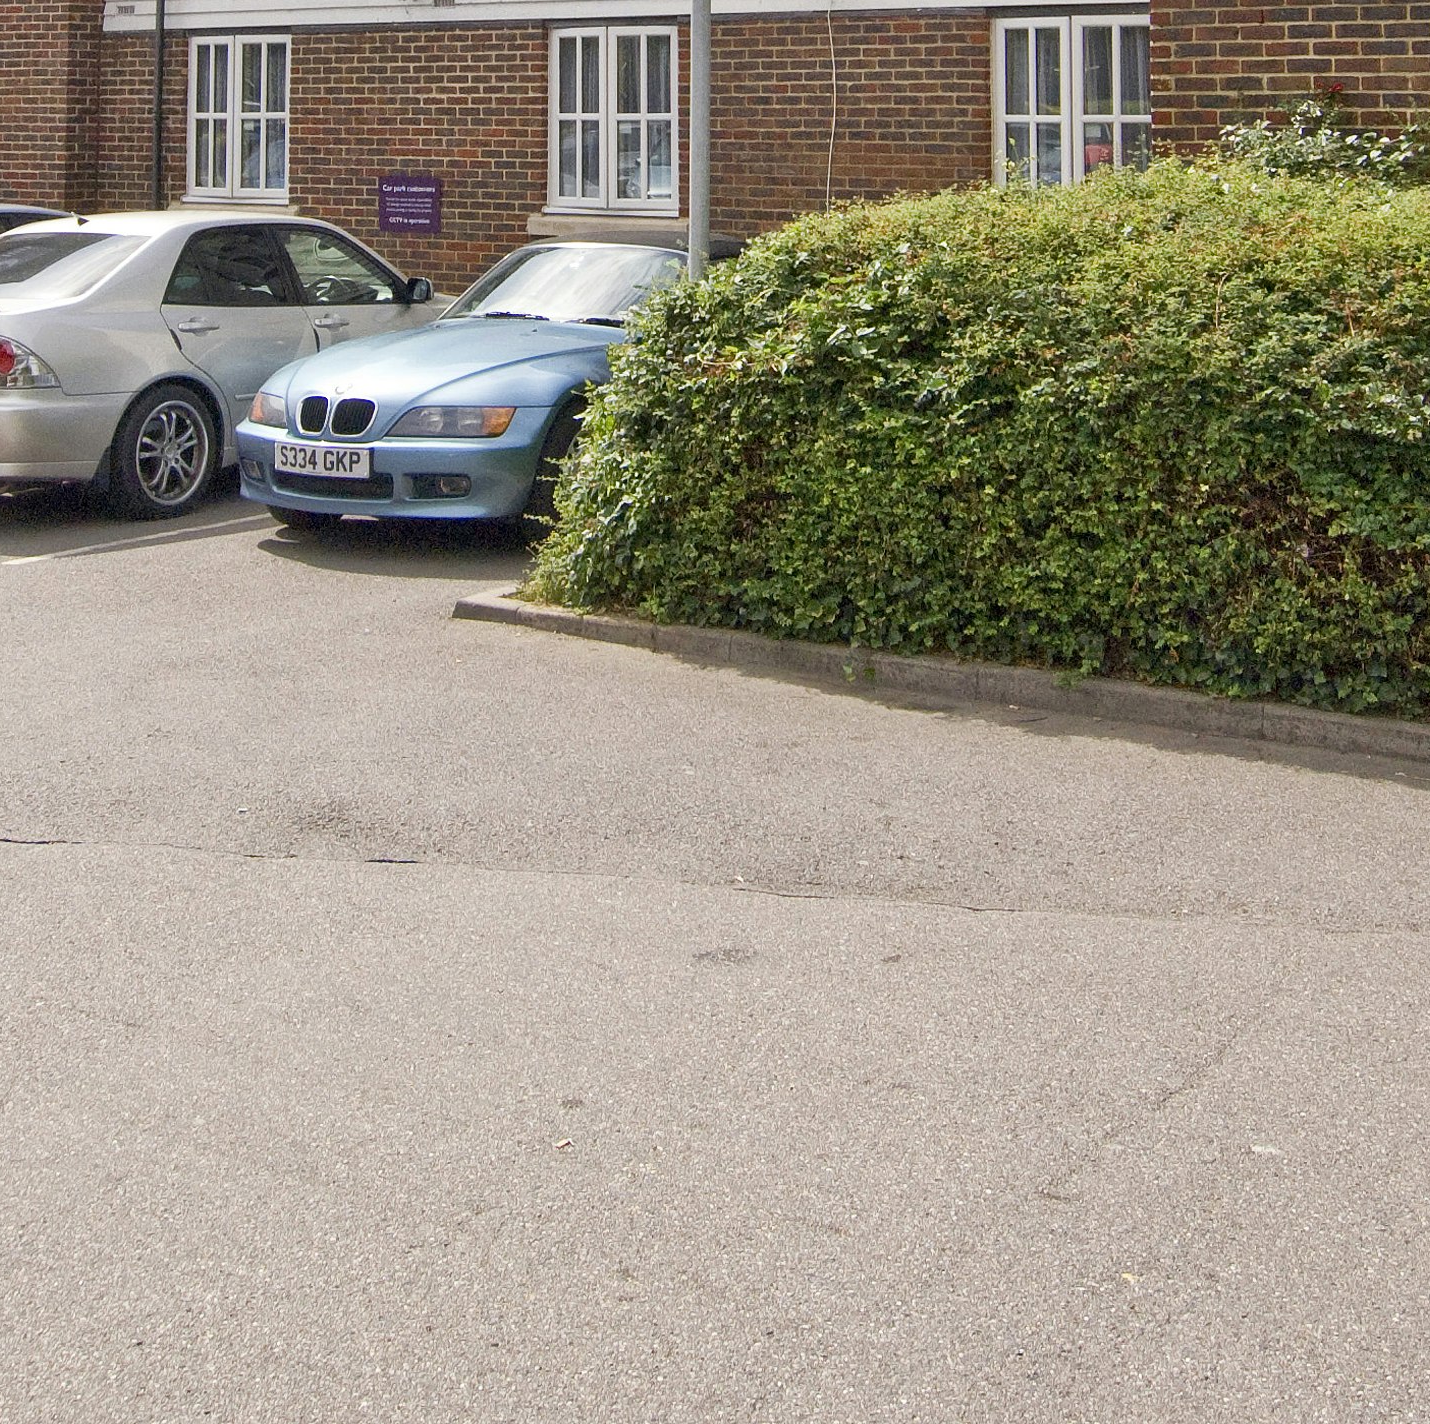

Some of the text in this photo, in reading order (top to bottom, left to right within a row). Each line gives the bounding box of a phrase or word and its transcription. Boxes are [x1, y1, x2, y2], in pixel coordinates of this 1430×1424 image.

[382, 184, 392, 192] Car
[393, 185, 406, 193] park
[280, 445, 361, 472] S334 GKP
